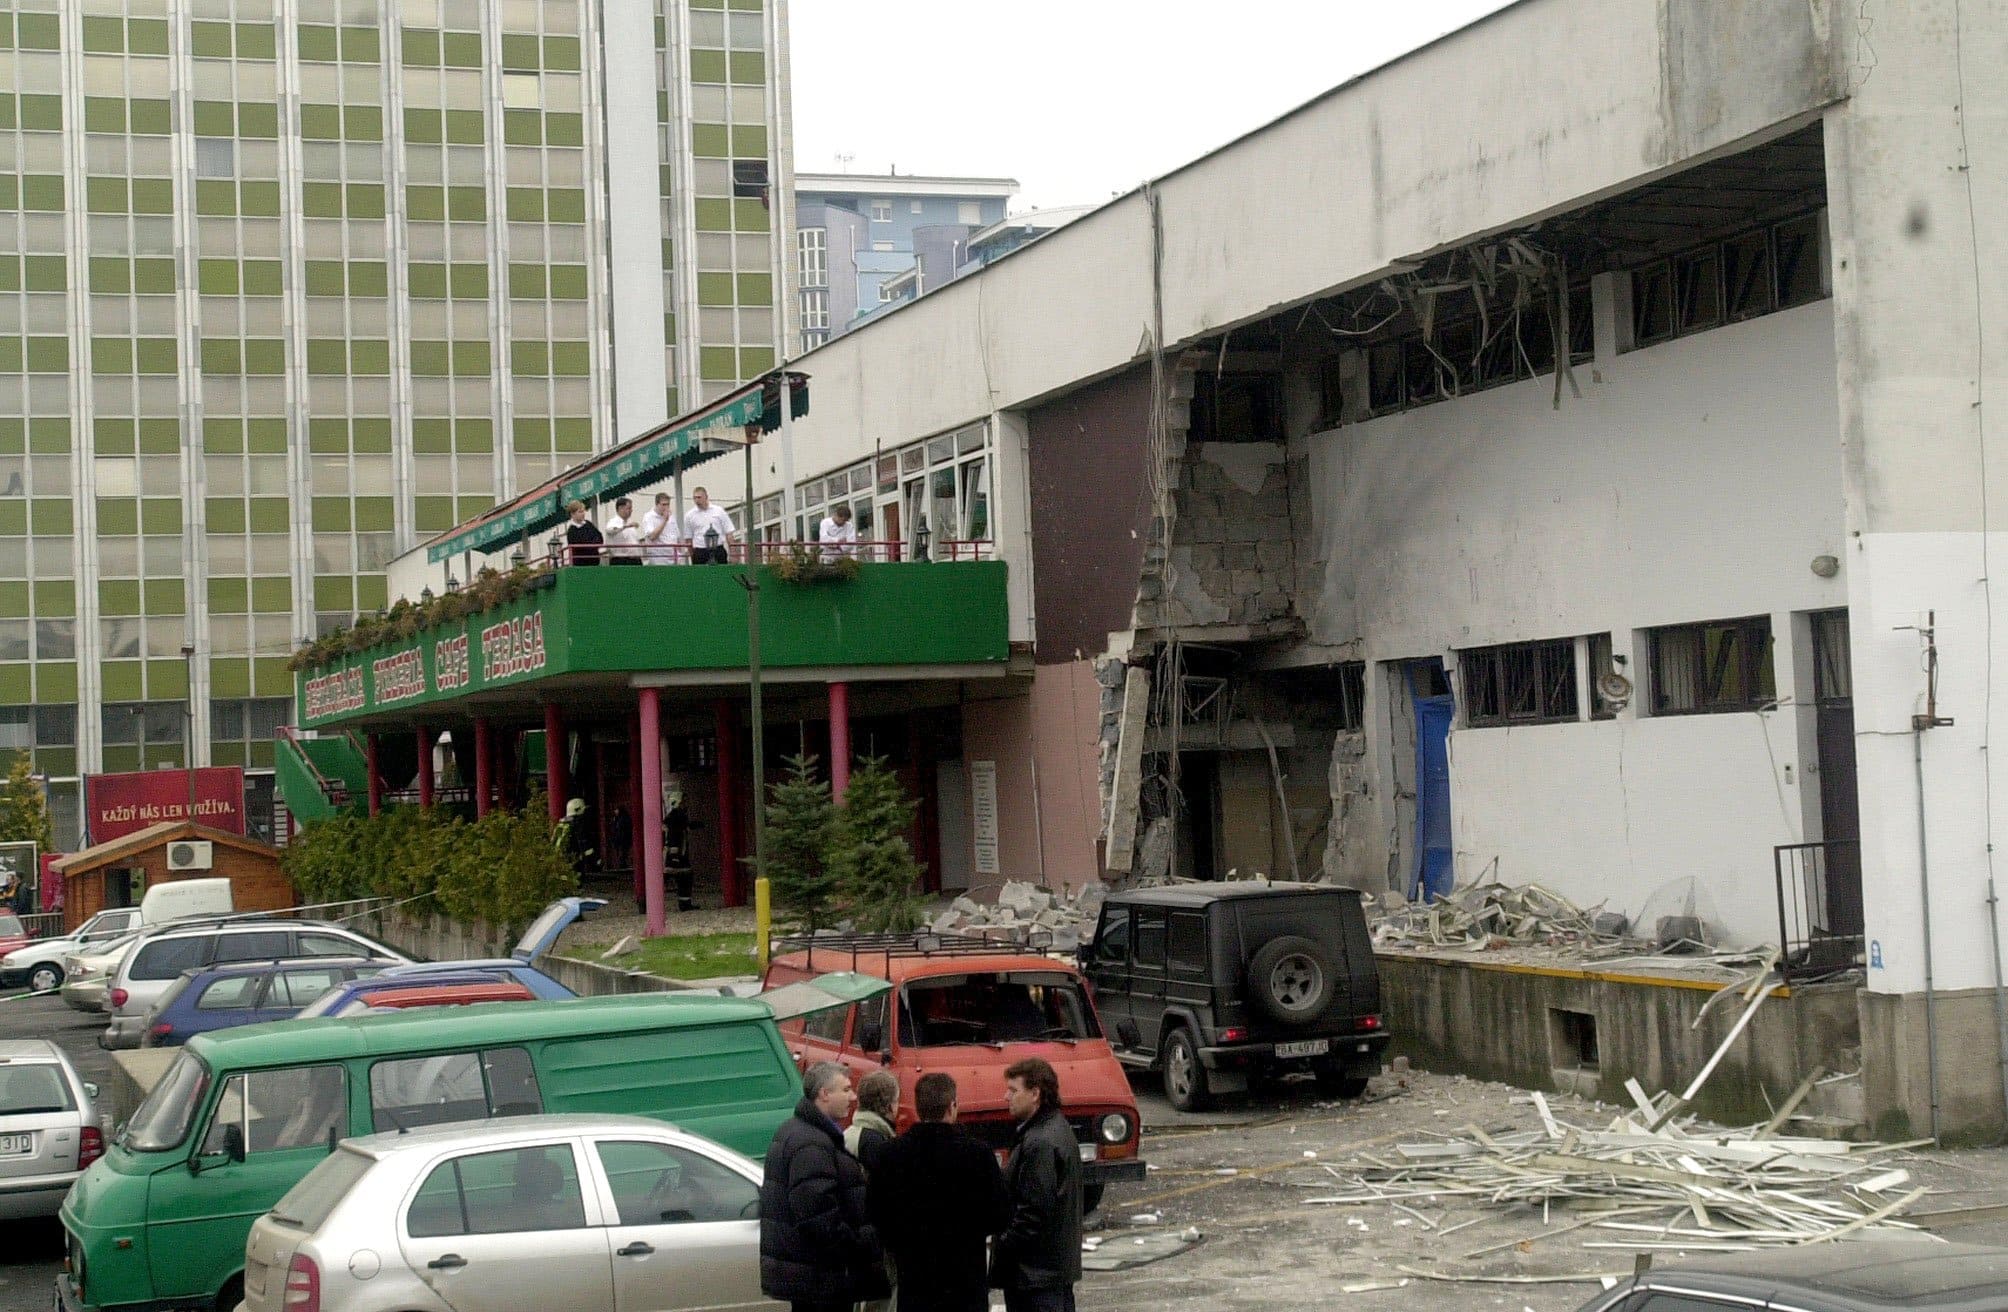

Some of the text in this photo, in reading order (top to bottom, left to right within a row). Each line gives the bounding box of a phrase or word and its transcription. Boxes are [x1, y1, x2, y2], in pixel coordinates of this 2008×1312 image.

[373, 646, 426, 704] PIZZERIA
[482, 610, 546, 682] TERASA
[101, 806, 136, 823] KAŽDÝ
[140, 804, 160, 820] NÁS
[163, 804, 182, 818] LEN
